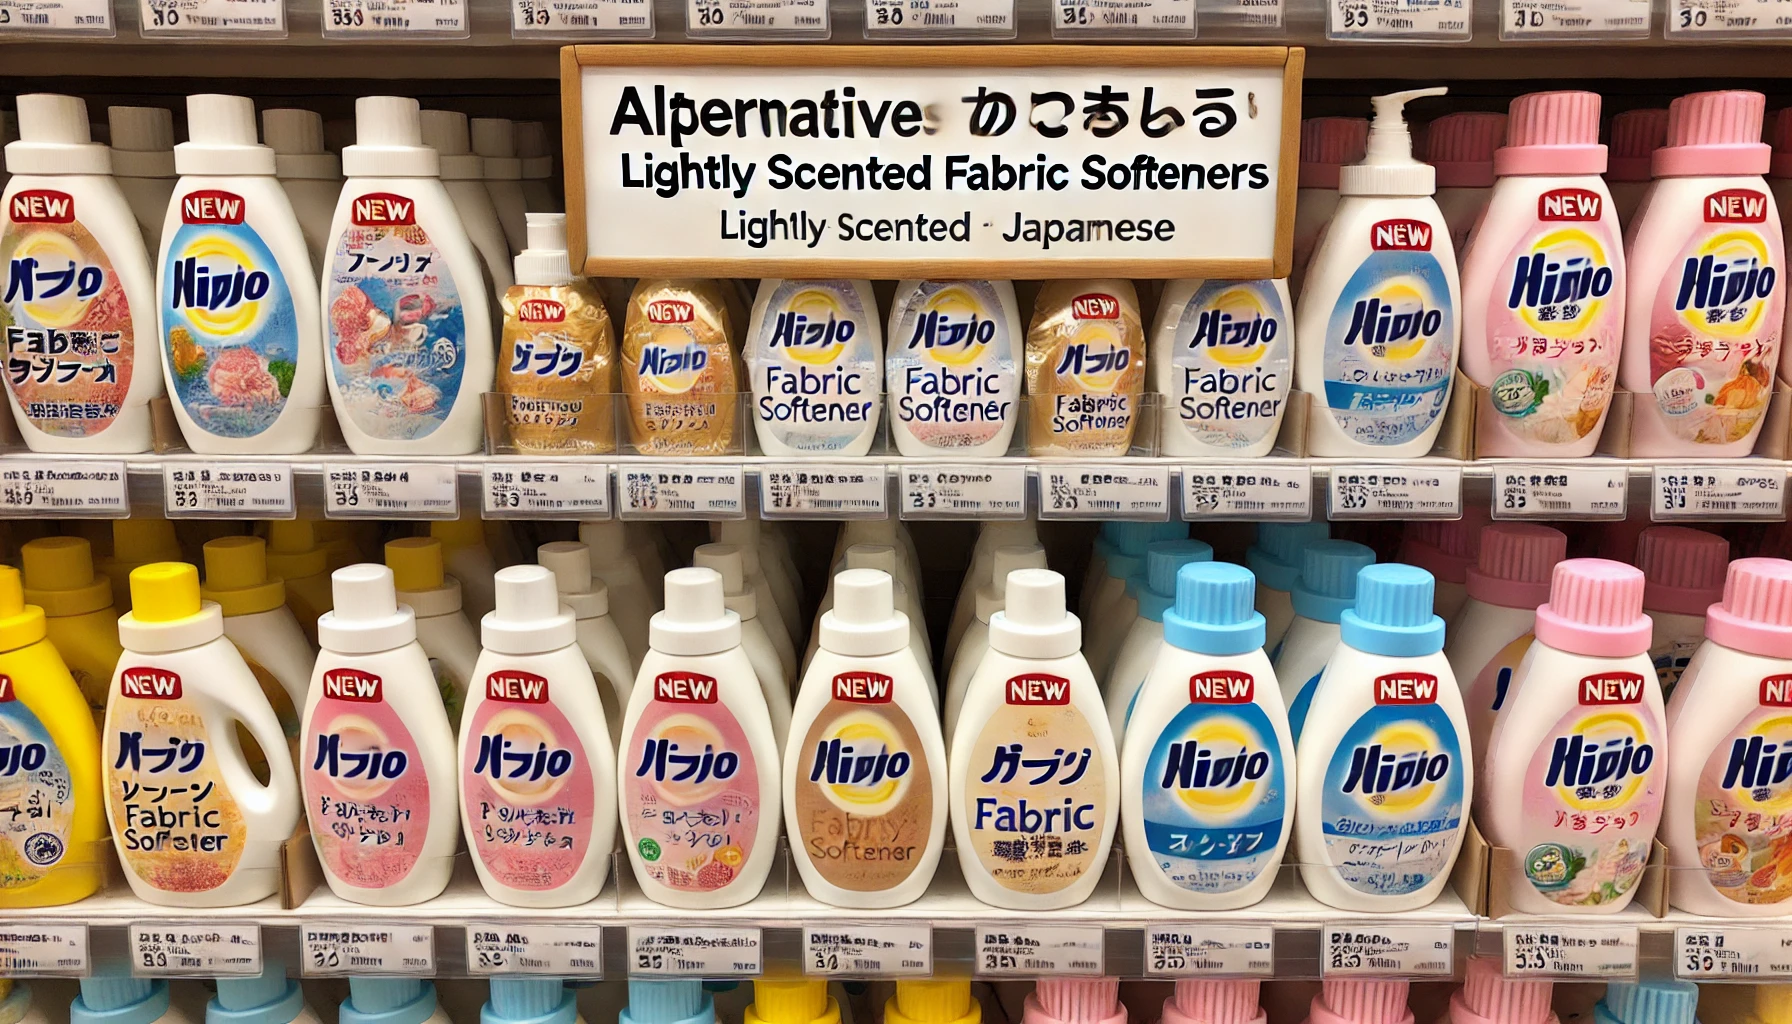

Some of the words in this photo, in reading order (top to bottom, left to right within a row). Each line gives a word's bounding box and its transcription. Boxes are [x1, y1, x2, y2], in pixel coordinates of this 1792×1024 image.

[621, 152, 757, 199] Lightly
[767, 153, 932, 190] Scented
[945, 153, 1069, 191] Fabric
[1081, 153, 1270, 190] Softeners
[14, 197, 69, 219] NEW
[184, 197, 240, 220] NEW
[356, 199, 411, 222] NEW
[1544, 196, 1599, 217] NEW
[1710, 196, 1765, 218] NEW
[838, 211, 971, 242] Scented
[1376, 225, 1430, 248] NEW
[1075, 299, 1116, 318] NEW
[767, 366, 862, 396] Fabric
[905, 366, 1000, 397] Fabric
[1185, 366, 1277, 394] Fabric
[760, 396, 873, 424] Softener
[899, 396, 1011, 424] Softener
[1179, 395, 1281, 422] Softener
[123, 673, 176, 696] NEW
[327, 675, 378, 698] NEW
[491, 678, 544, 699] NEW
[660, 680, 713, 700] NEW
[837, 677, 889, 698] NEW
[1011, 679, 1067, 702] NEW
[1196, 677, 1251, 699] NEW
[1380, 678, 1435, 700] NEW
[1586, 679, 1642, 701] NEW
[126, 804, 220, 829] Fabric
[974, 796, 1095, 833] Fabric
[811, 836, 917, 863] Softener
